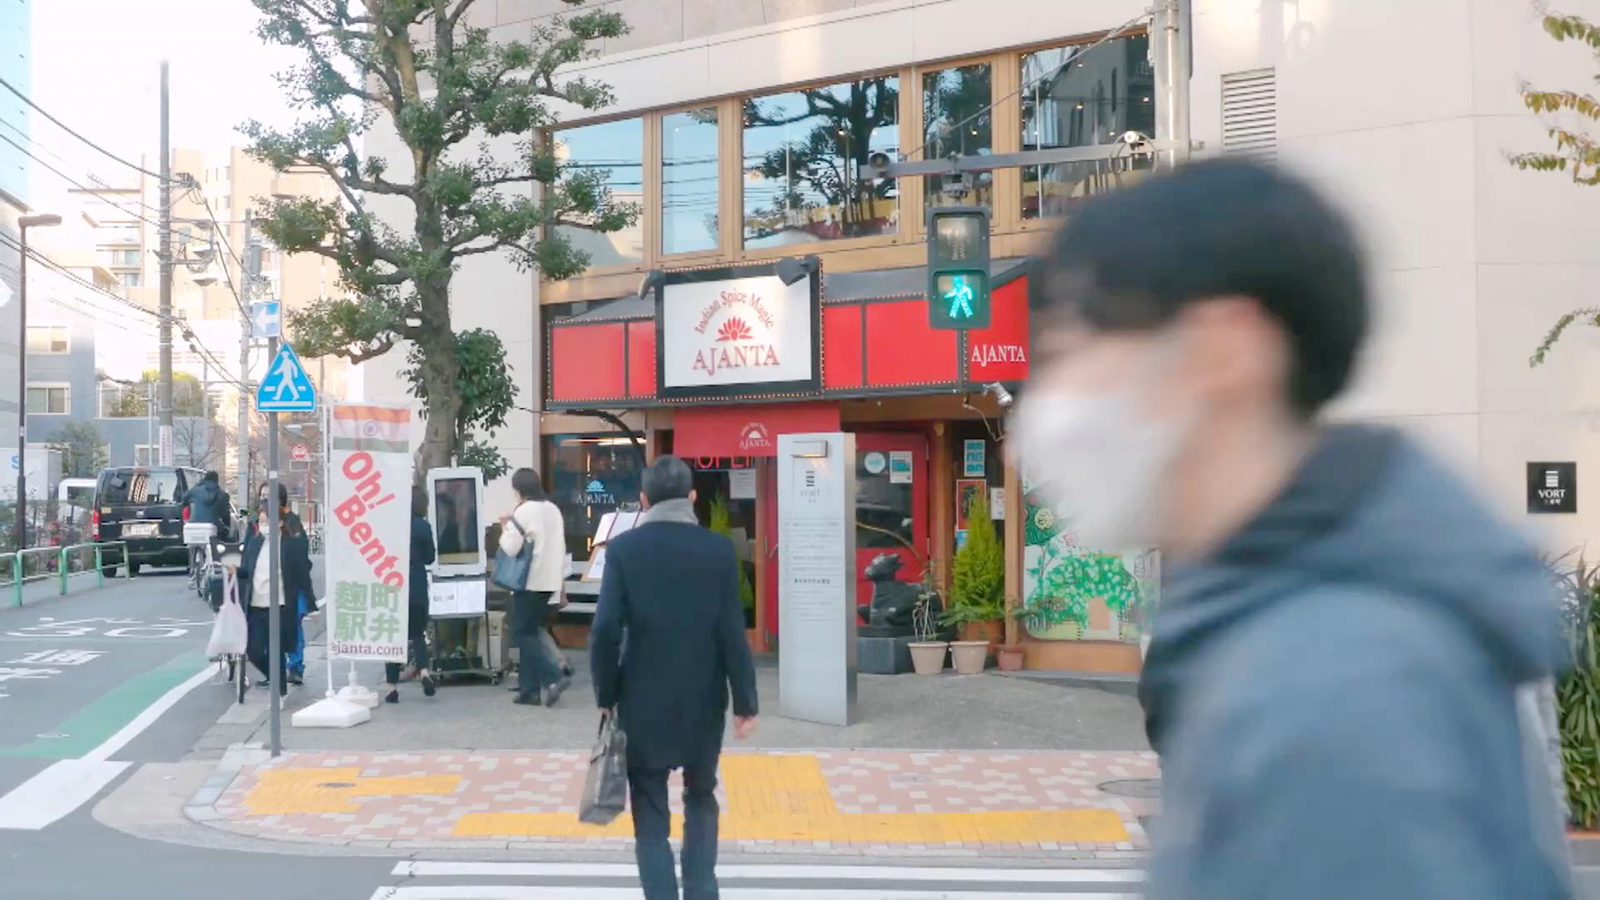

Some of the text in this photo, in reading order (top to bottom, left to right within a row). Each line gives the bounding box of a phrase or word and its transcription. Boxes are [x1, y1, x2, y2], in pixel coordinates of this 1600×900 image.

[694, 288, 774, 334] Indian Spice Magic
[692, 344, 780, 376] AJANTA
[971, 344, 1026, 367] AJANTA
[739, 439, 771, 450] AJANTA
[342, 452, 396, 510] Oh!
[1538, 489, 1566, 498] VORT
[575, 493, 616, 507] AJANTA
[333, 494, 405, 592] Bento
[334, 612, 401, 643] 駅弁
[331, 641, 404, 656] ajanta.com
